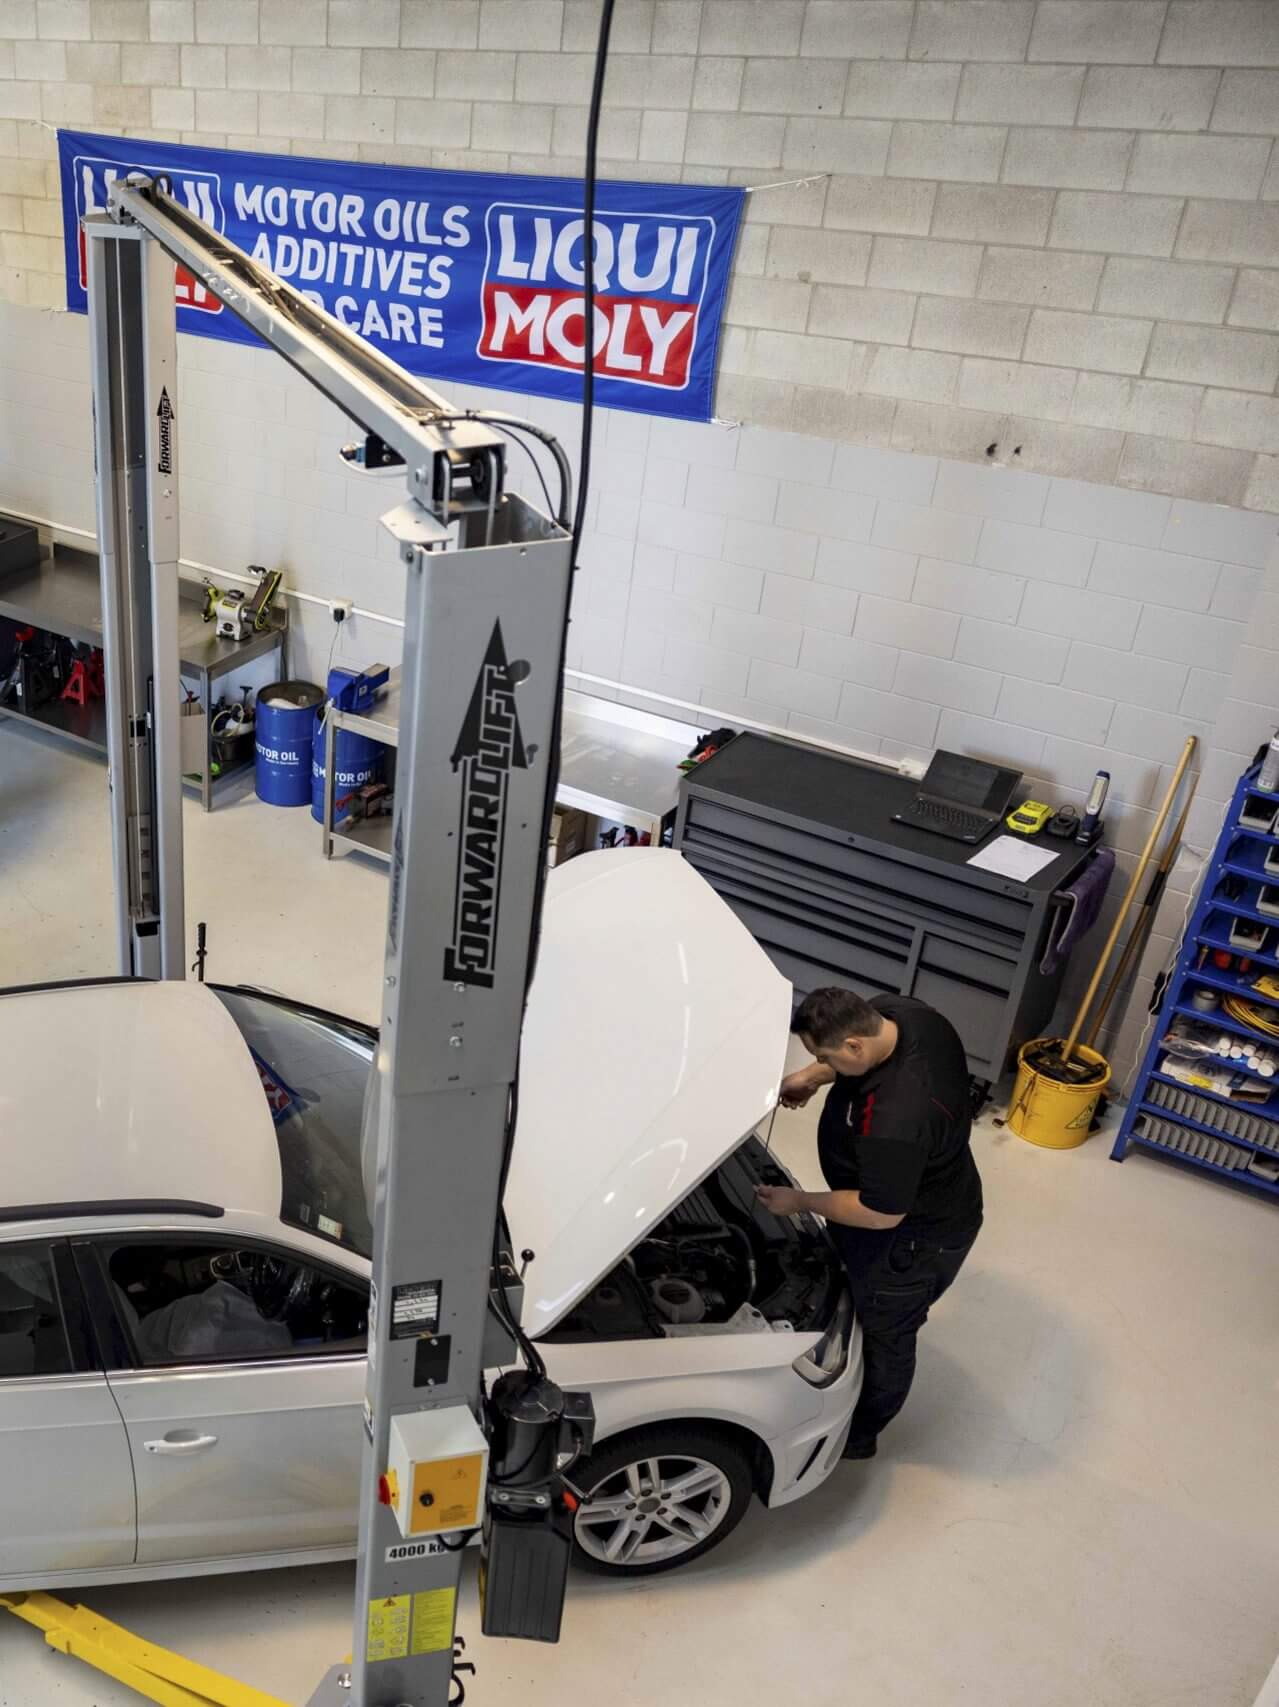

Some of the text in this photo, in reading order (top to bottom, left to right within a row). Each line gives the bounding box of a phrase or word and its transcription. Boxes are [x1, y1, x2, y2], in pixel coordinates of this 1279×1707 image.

[234, 182, 470, 247] MOTOR OILS
[251, 232, 454, 299] ADDITIVES
[497, 214, 700, 295] LIQUI
[334, 295, 445, 348] CARE
[489, 291, 694, 376] MOLY
[280, 751, 299, 761] OIL
[389, 1544, 425, 1559] 4000
